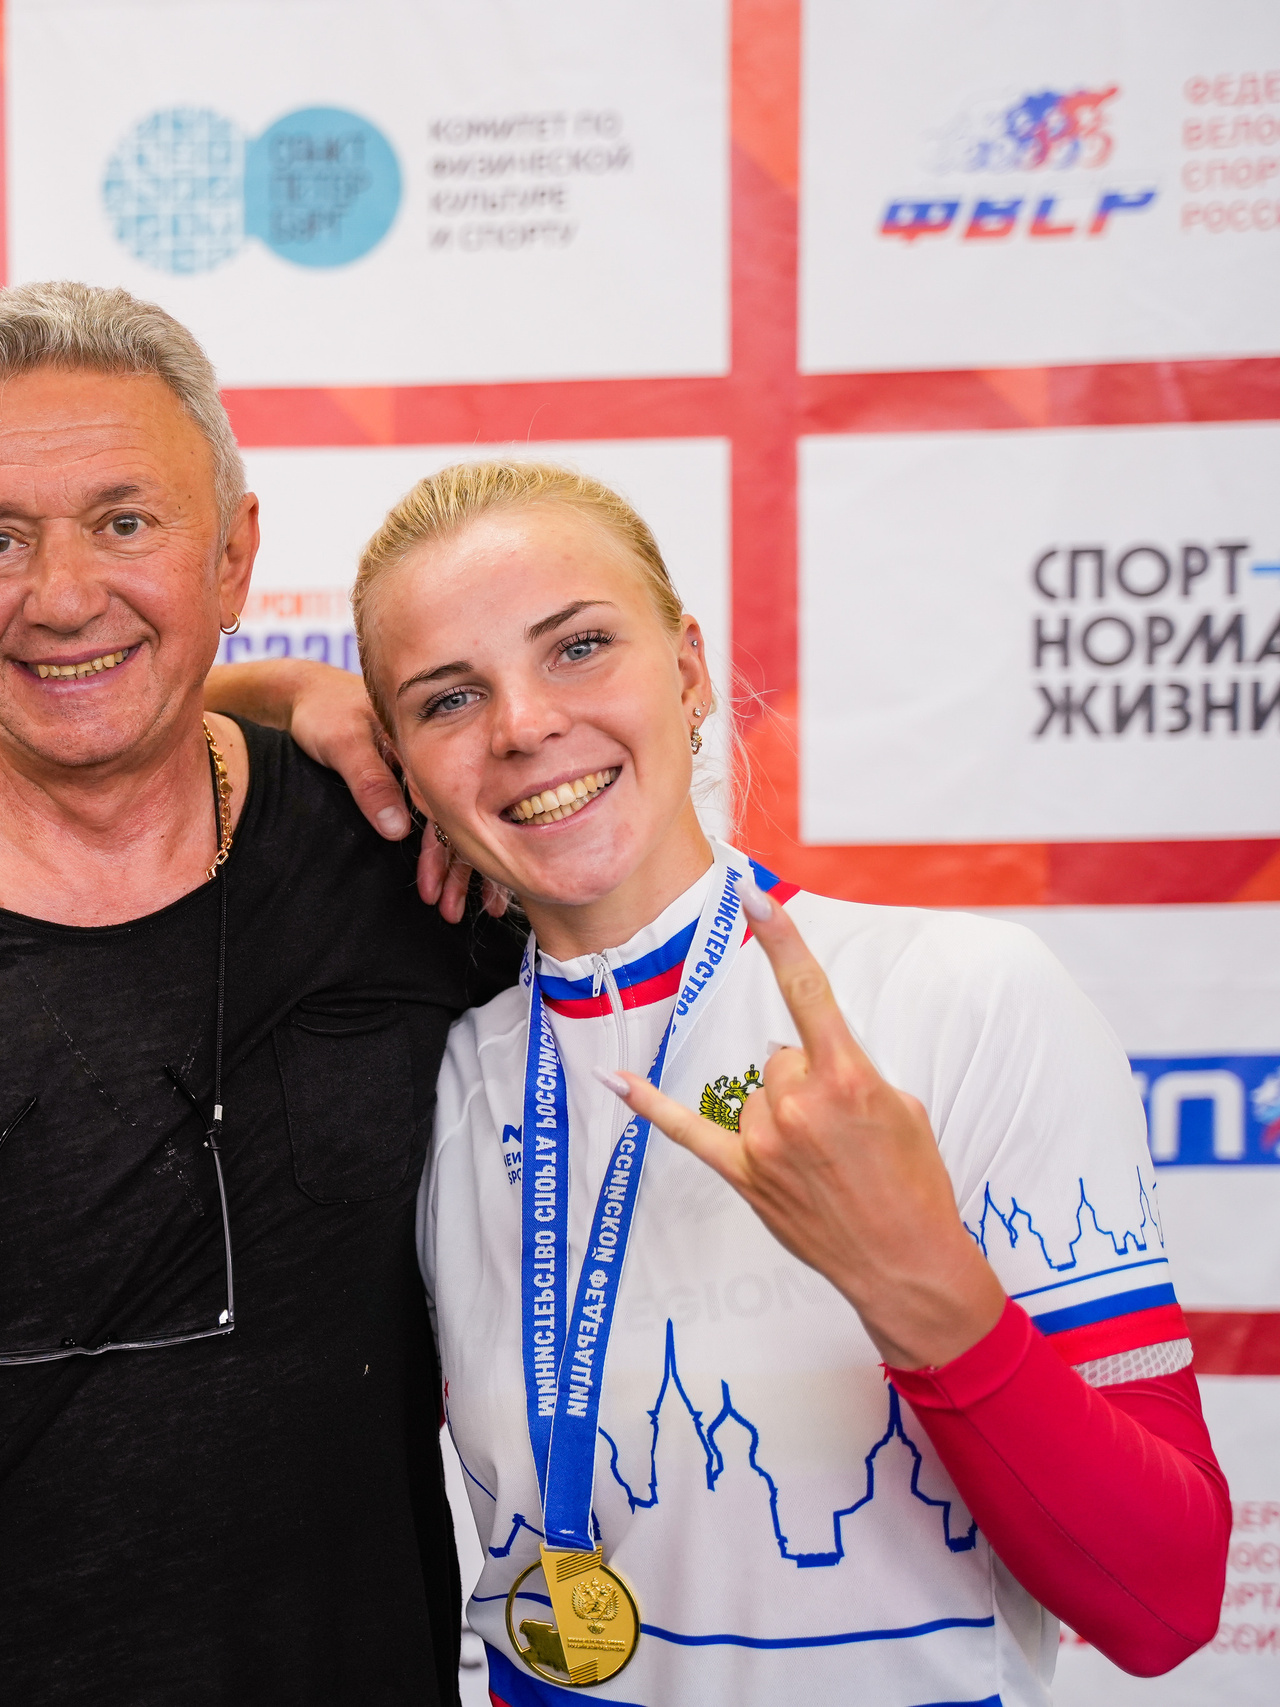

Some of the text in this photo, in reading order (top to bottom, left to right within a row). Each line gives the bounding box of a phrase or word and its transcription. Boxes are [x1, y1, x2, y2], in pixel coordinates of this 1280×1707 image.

[428, 108, 622, 145] КОМИТЕТ ПО
[428, 143, 632, 179] ФИЗИЧЕСКОЙ
[428, 184, 570, 215] КУЛЬТУРЕ
[458, 219, 578, 251] СПОРТУ
